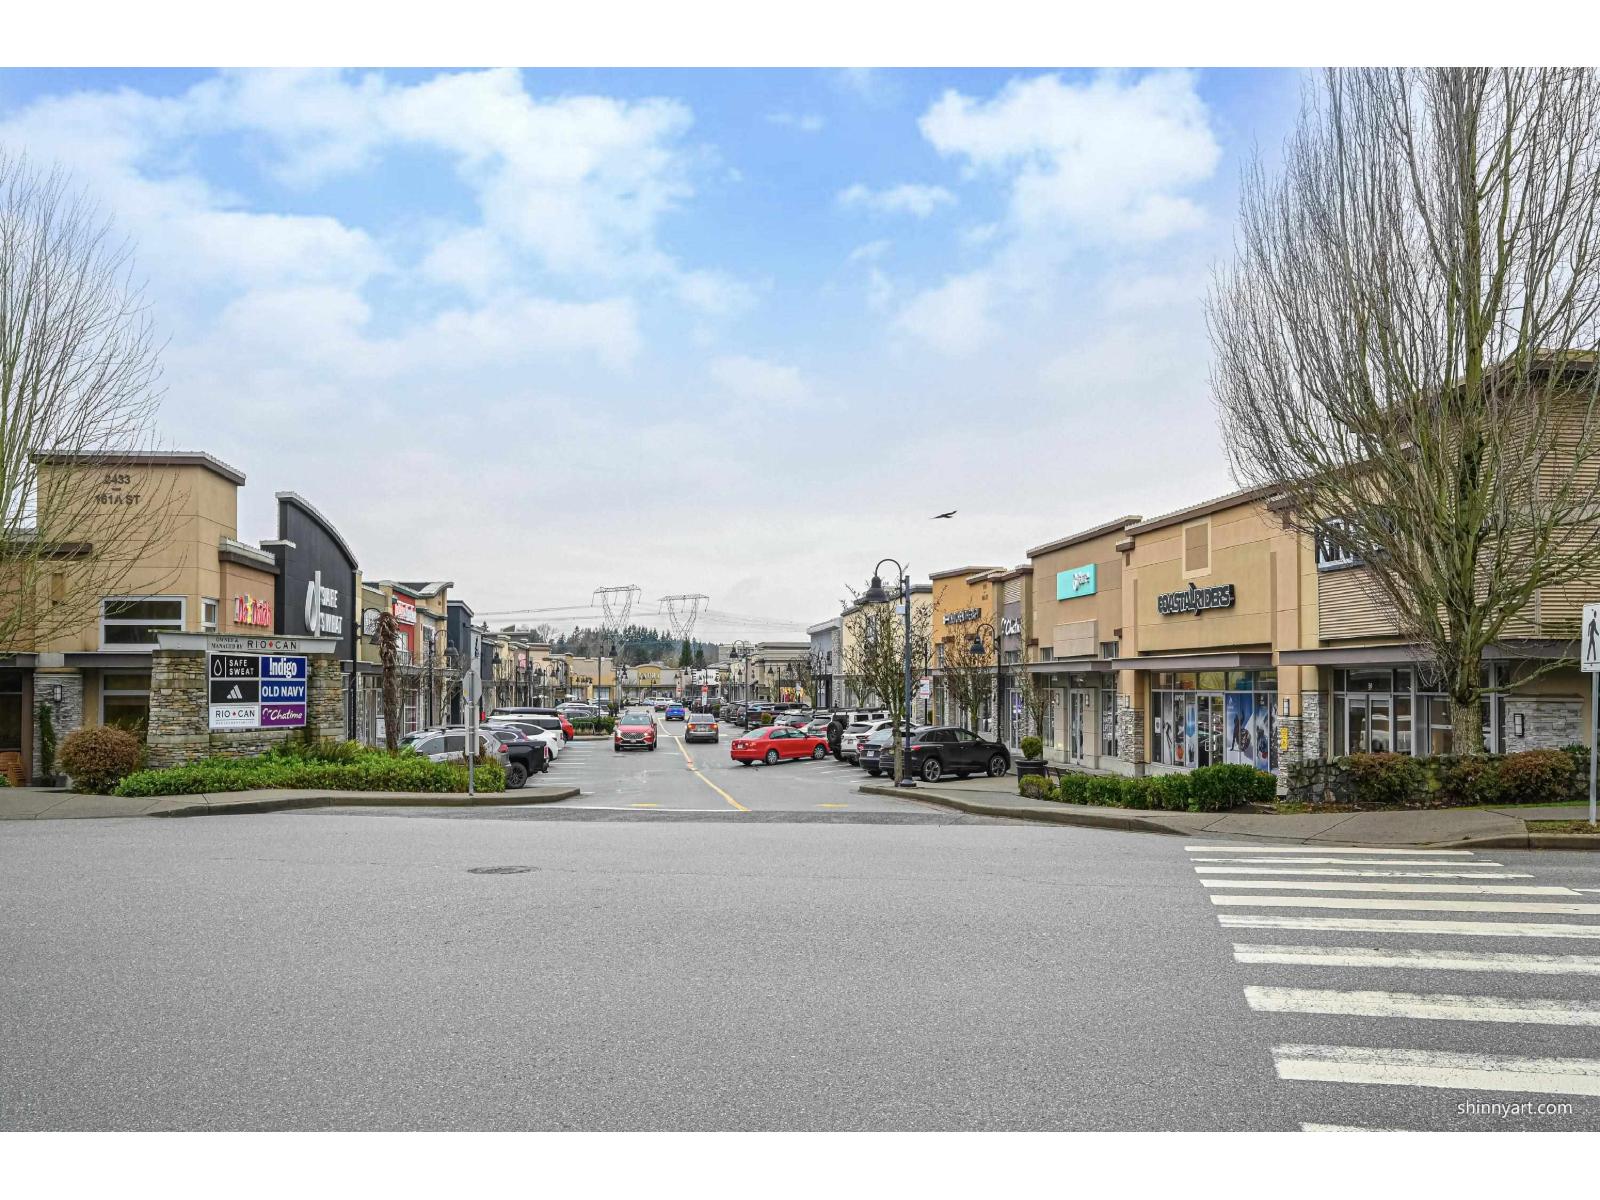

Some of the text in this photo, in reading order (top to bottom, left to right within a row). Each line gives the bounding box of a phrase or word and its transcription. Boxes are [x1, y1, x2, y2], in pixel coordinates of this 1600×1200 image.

[126, 494, 141, 505] ST
[1158, 584, 1231, 614] COASTAL RIDERS
[247, 640, 298, 650] RIO CAN
[229, 659, 248, 667] SAFE
[269, 657, 298, 679] Indigo
[229, 667, 254, 675] SWEAT
[262, 685, 304, 697] OLD NAVY
[215, 709, 255, 718] RIO CAN
[270, 708, 303, 720] Chatime
